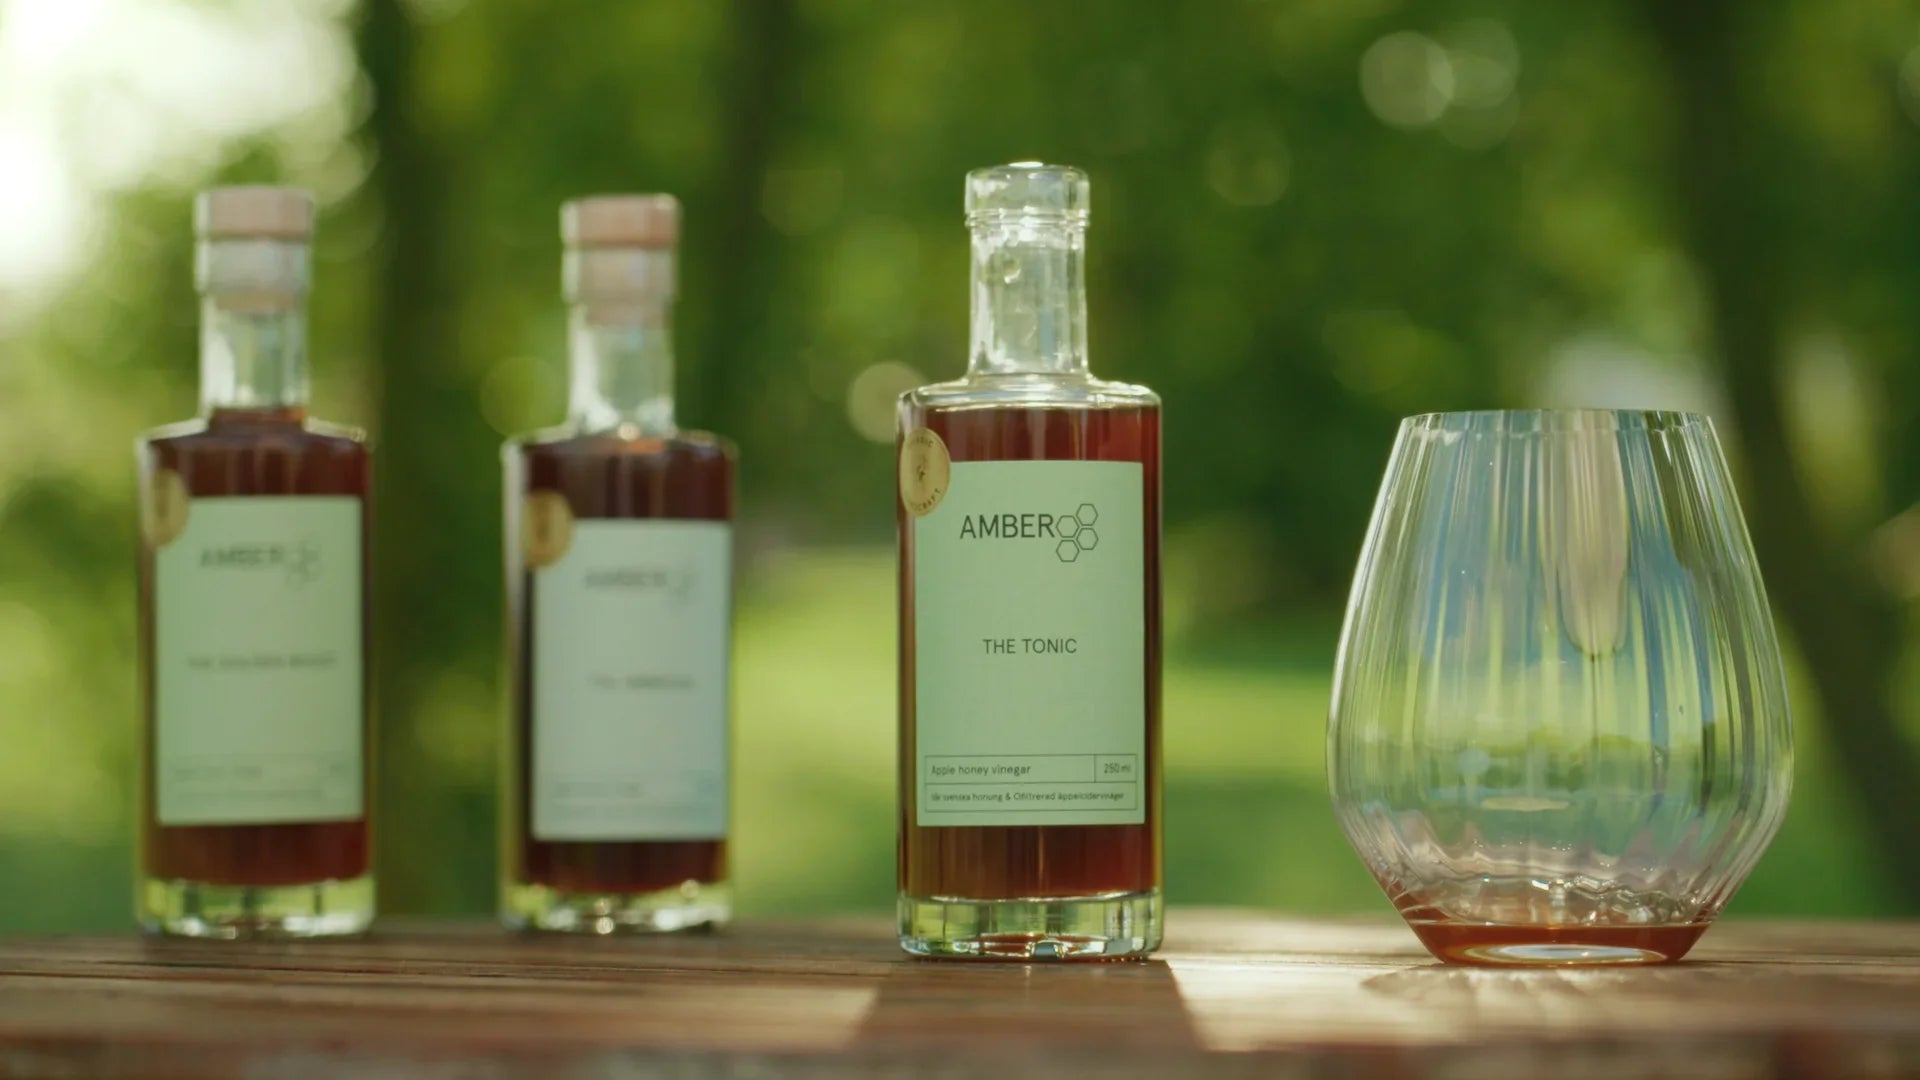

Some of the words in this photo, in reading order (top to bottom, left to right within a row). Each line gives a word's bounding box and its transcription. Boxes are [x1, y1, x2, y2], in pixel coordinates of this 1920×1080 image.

[959, 513, 1055, 539] AMBER
[983, 639, 1016, 654] THE
[1022, 638, 1077, 653] TONIC
[931, 765, 955, 776] Apple
[958, 765, 988, 776] honey
[991, 764, 1031, 777] vinegar
[1103, 763, 1119, 774] 250
[1005, 792, 1011, 801] &
